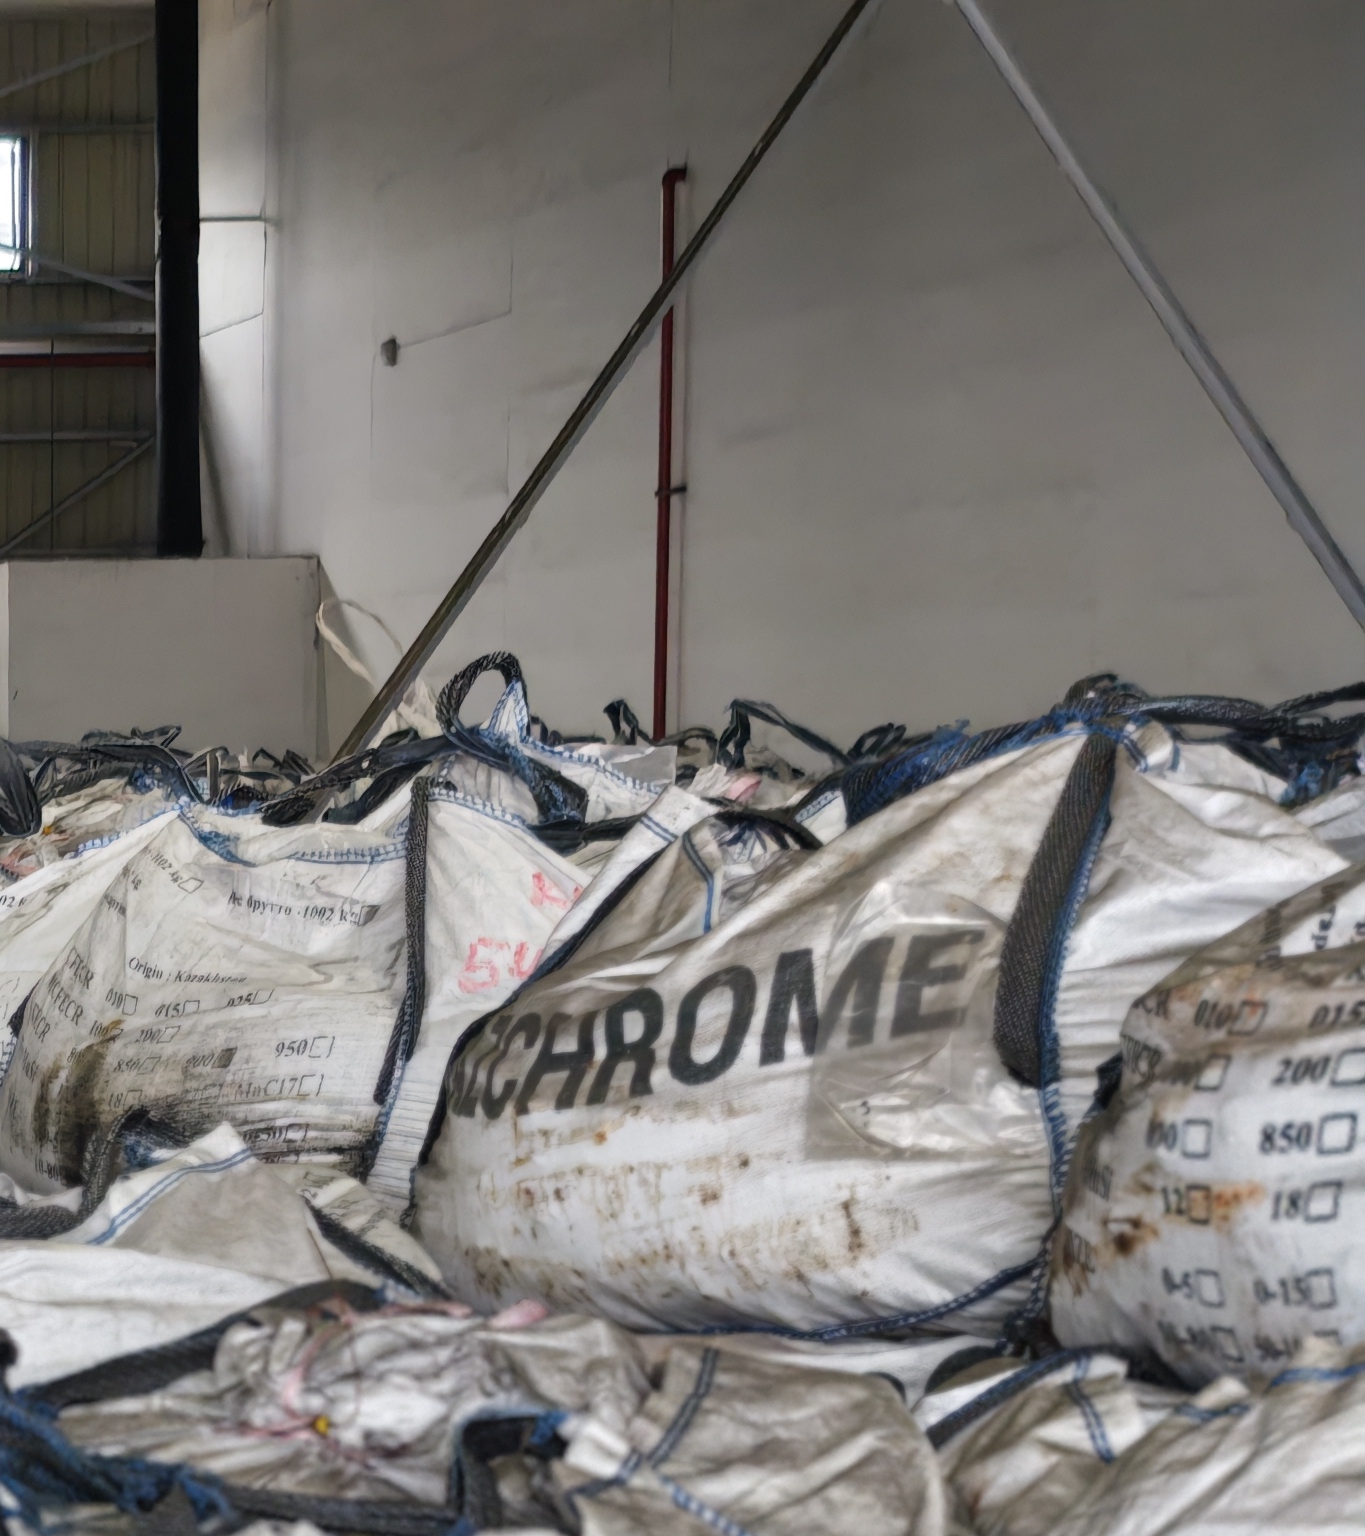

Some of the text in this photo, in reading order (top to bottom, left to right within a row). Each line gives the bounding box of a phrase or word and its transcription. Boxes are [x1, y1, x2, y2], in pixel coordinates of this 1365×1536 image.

[129, 957, 164, 980] Origin
[275, 1041, 308, 1058] 950
[1272, 1056, 1330, 1086] 200
[1260, 1122, 1313, 1156] 850
[1271, 1188, 1304, 1221] 18
